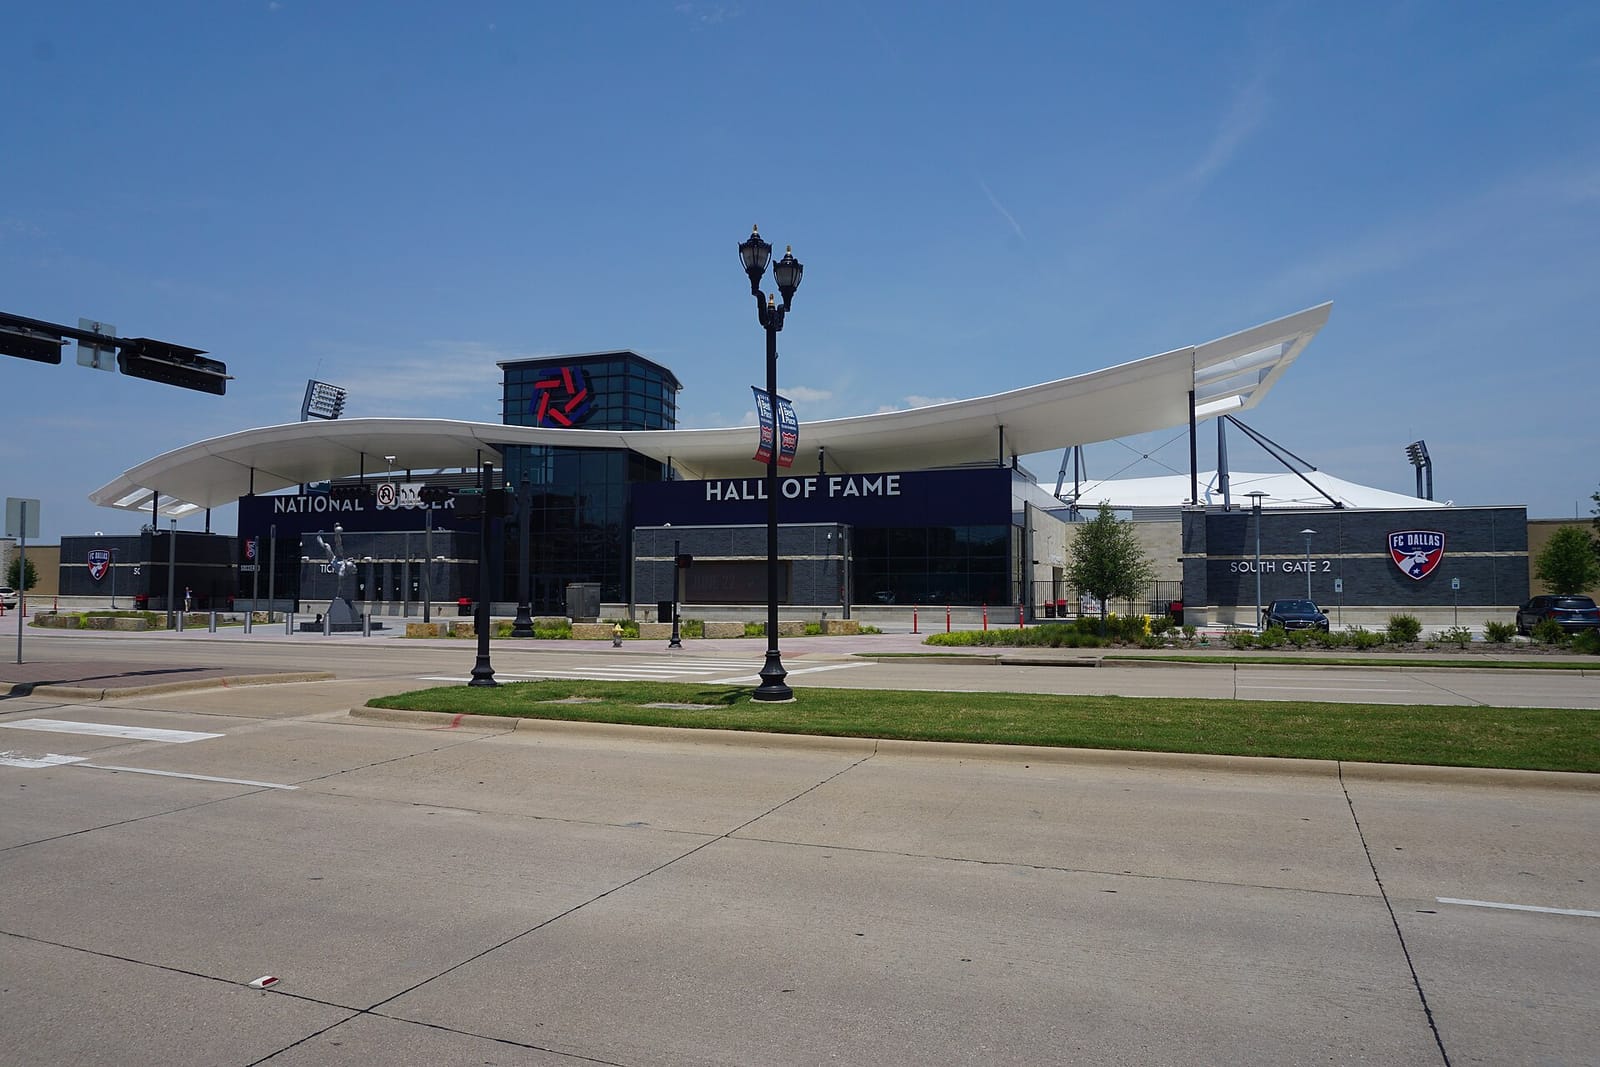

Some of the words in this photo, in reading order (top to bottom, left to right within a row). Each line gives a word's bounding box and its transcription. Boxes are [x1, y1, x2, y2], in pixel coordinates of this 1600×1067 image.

[706, 480, 769, 501] HALL
[781, 478, 817, 499] OF
[829, 475, 901, 497] FAME
[273, 495, 364, 513] NATIONAL
[1393, 535, 1404, 547] FC
[1407, 534, 1440, 547] DALLAS
[1230, 561, 1276, 574] SOUTH
[1282, 561, 1317, 573] GATE
[1322, 560, 1331, 572] 2
